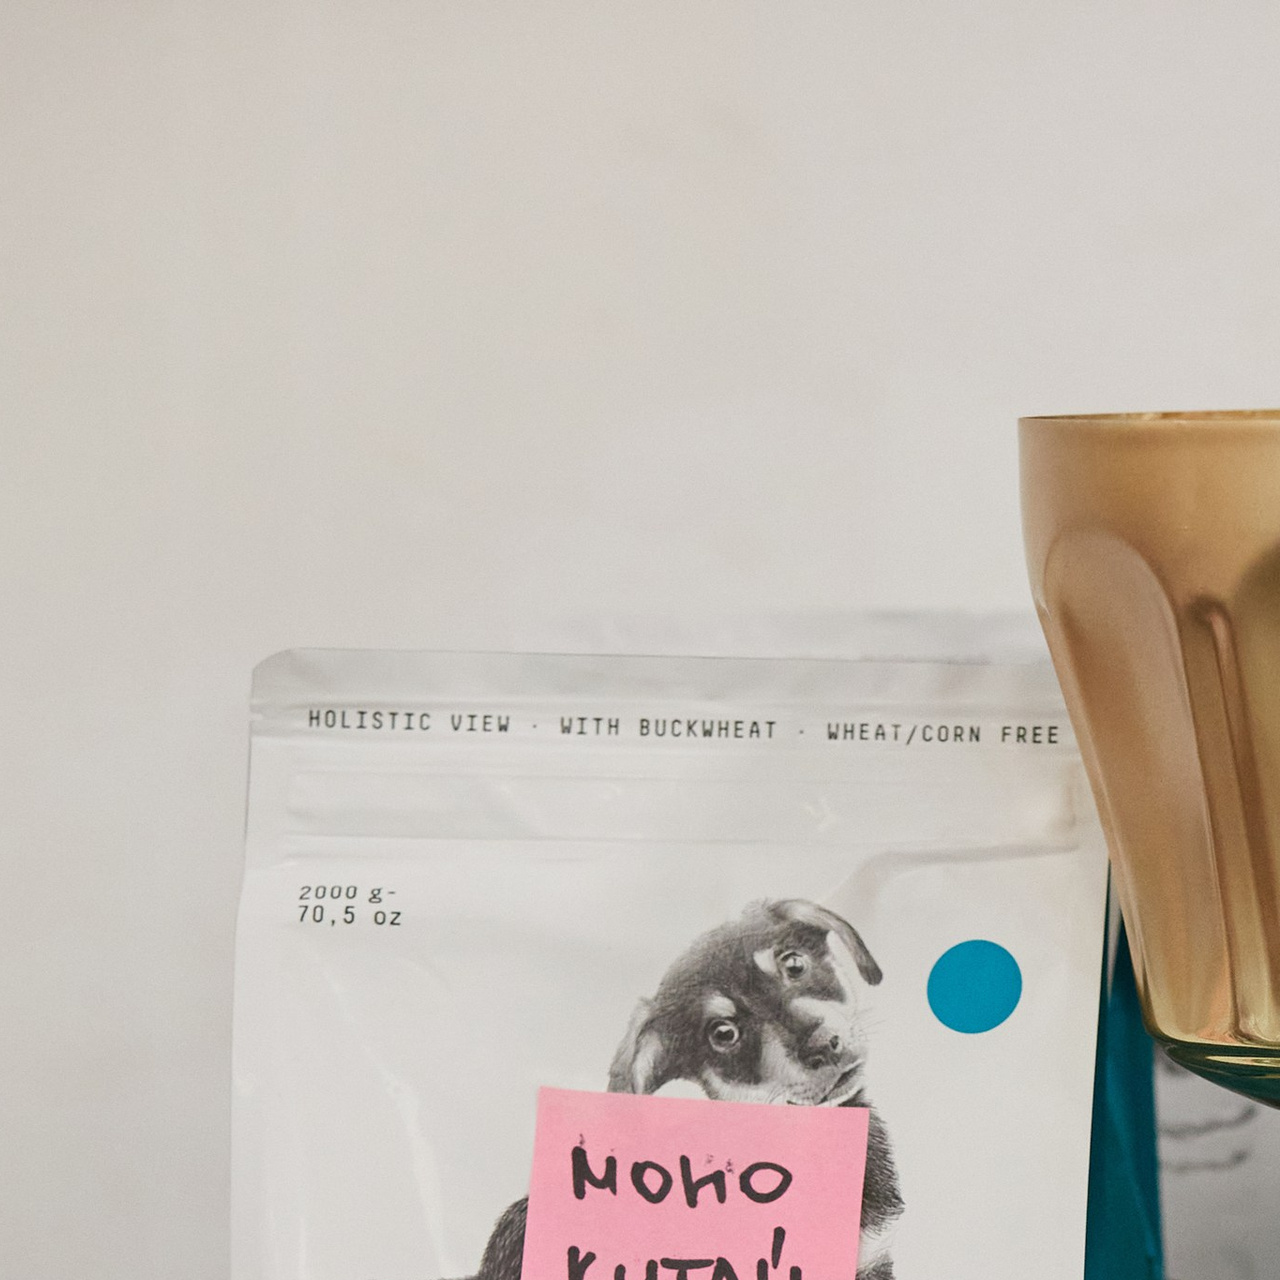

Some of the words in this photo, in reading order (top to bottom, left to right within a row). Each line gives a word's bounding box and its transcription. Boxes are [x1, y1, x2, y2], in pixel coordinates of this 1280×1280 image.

[307, 710, 432, 732] HOLISTIC
[450, 713, 511, 734] VIEW
[559, 717, 620, 737] WITH
[639, 719, 777, 740] BUCKWHEAT
[826, 723, 982, 747] WHEAT/CORN
[1000, 725, 1060, 745] FREE
[298, 884, 358, 902] 2000
[368, 885, 397, 905] g-
[297, 903, 356, 927] 70,5
[373, 907, 402, 927] oz
